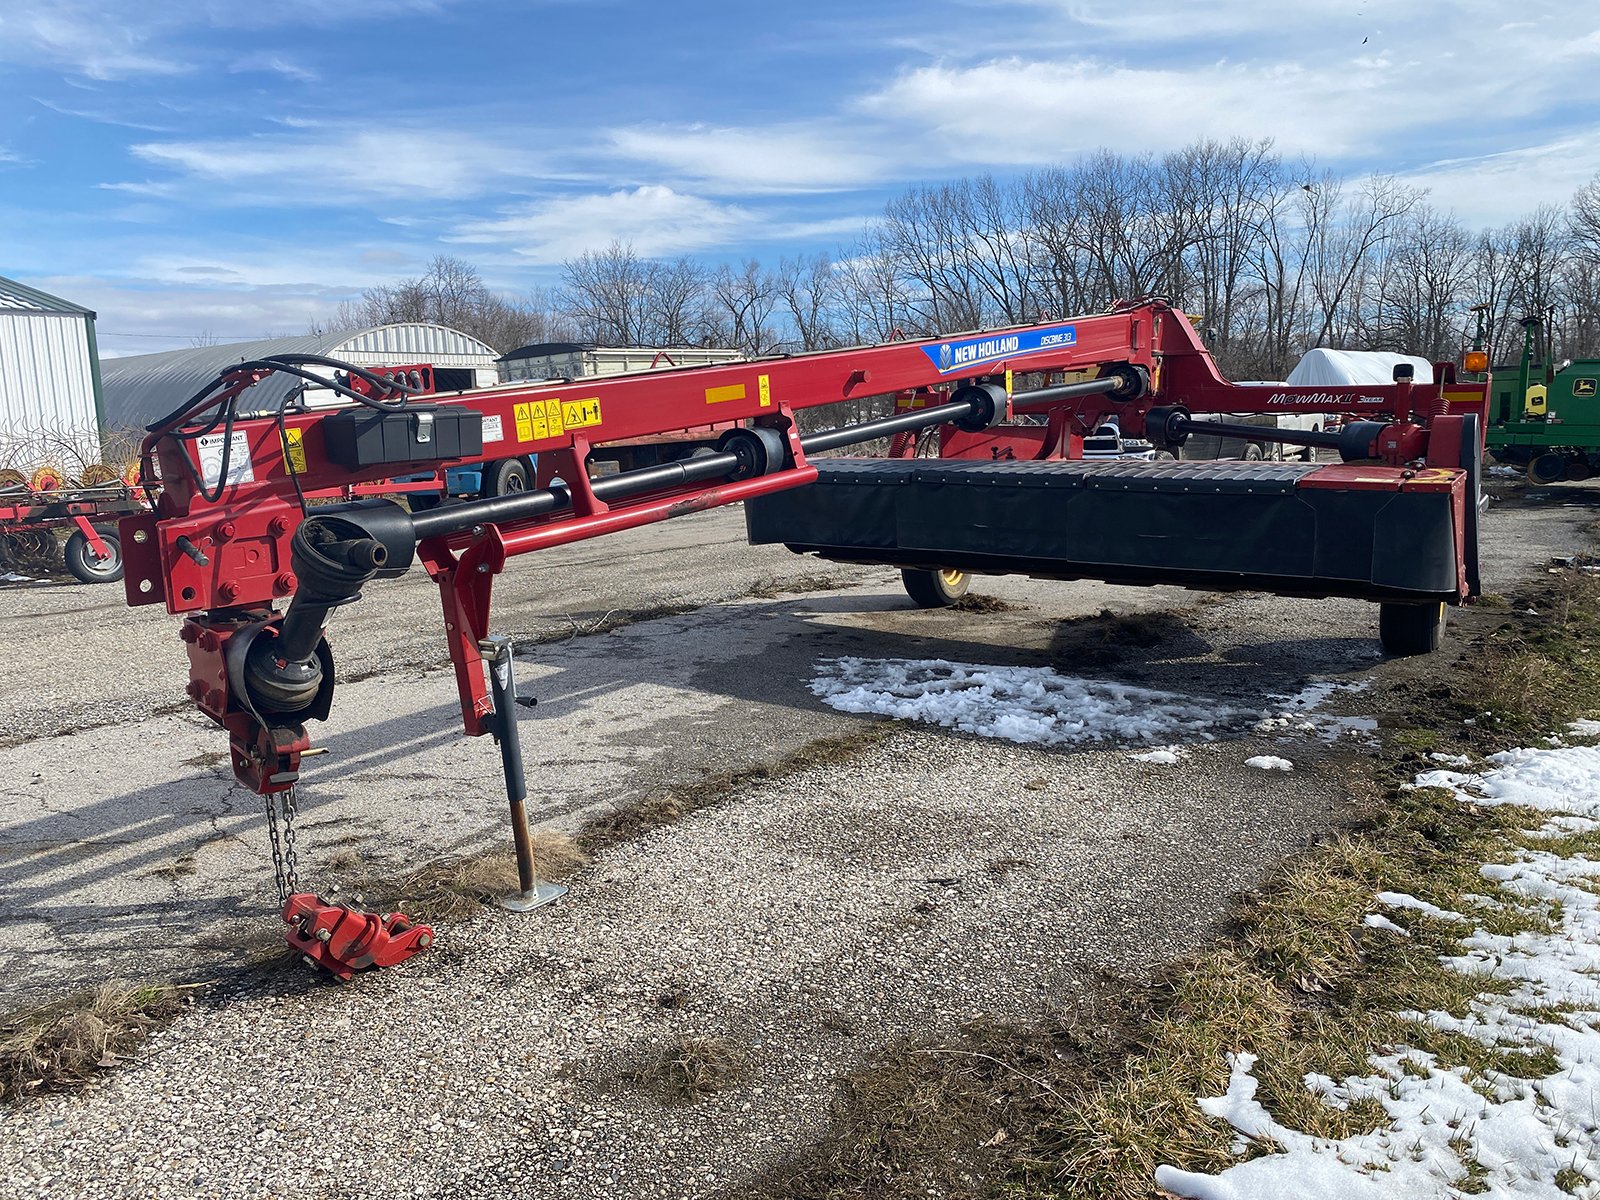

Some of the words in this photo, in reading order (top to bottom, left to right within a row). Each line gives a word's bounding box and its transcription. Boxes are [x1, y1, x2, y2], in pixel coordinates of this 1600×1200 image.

[955, 345, 977, 363] NEW
[979, 336, 1019, 358] HOLLAND
[210, 435, 243, 444] IMPOANT
